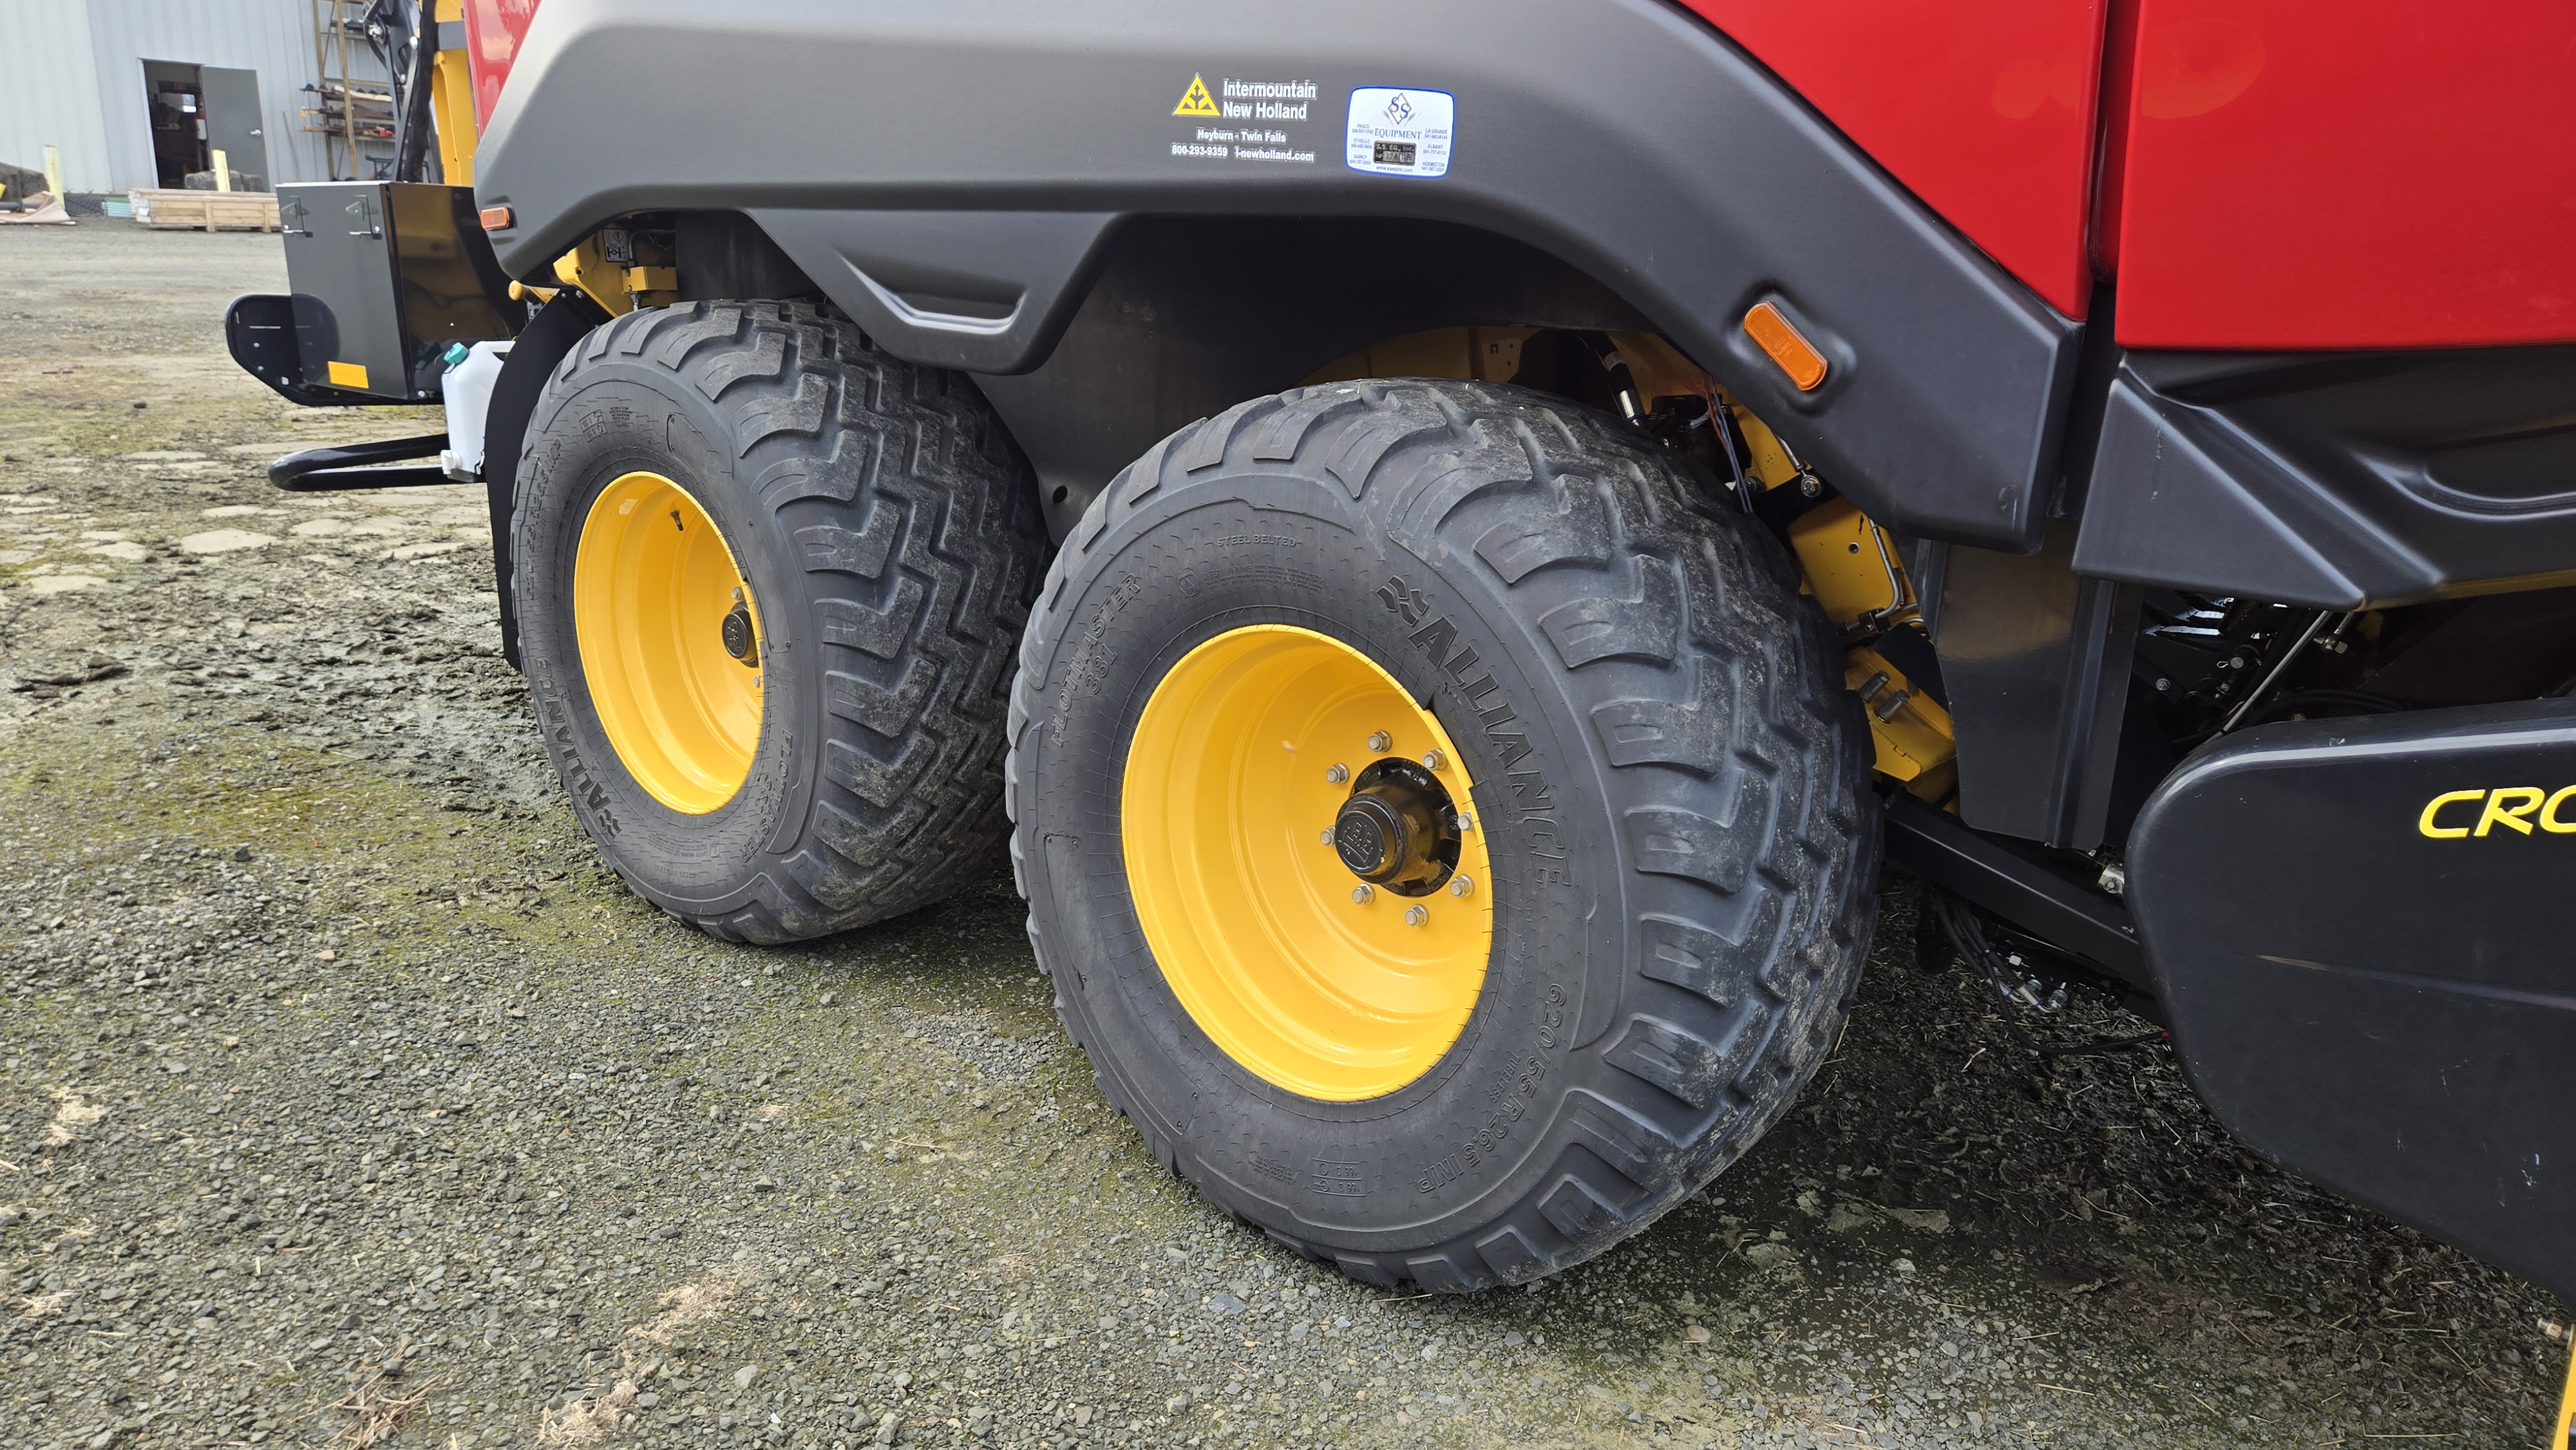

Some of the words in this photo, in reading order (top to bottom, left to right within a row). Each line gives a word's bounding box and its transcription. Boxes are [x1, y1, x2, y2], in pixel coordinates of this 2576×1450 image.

[1224, 79, 1316, 99] Intermountain
[1223, 101, 1252, 117] New
[1256, 101, 1307, 119] Holland
[1197, 129, 1234, 141] Heyburn
[1240, 130, 1263, 141] Twin
[1264, 131, 1287, 142] Falls
[1374, 128, 1422, 139] EQUIPMENT
[1171, 144, 1228, 156] 800-293-9359
[1217, 534, 1251, 547] STEEL
[1254, 534, 1296, 547] BELTED
[1049, 573, 1142, 748] FLOTMASTER
[1085, 643, 1119, 694] 381
[1408, 615, 1571, 886] ALLIANCE
[1462, 983, 1566, 1167] 620/55R26.5
[1489, 1052, 1522, 1104] TUBELESS
[1417, 1154, 1465, 1194] IMP
